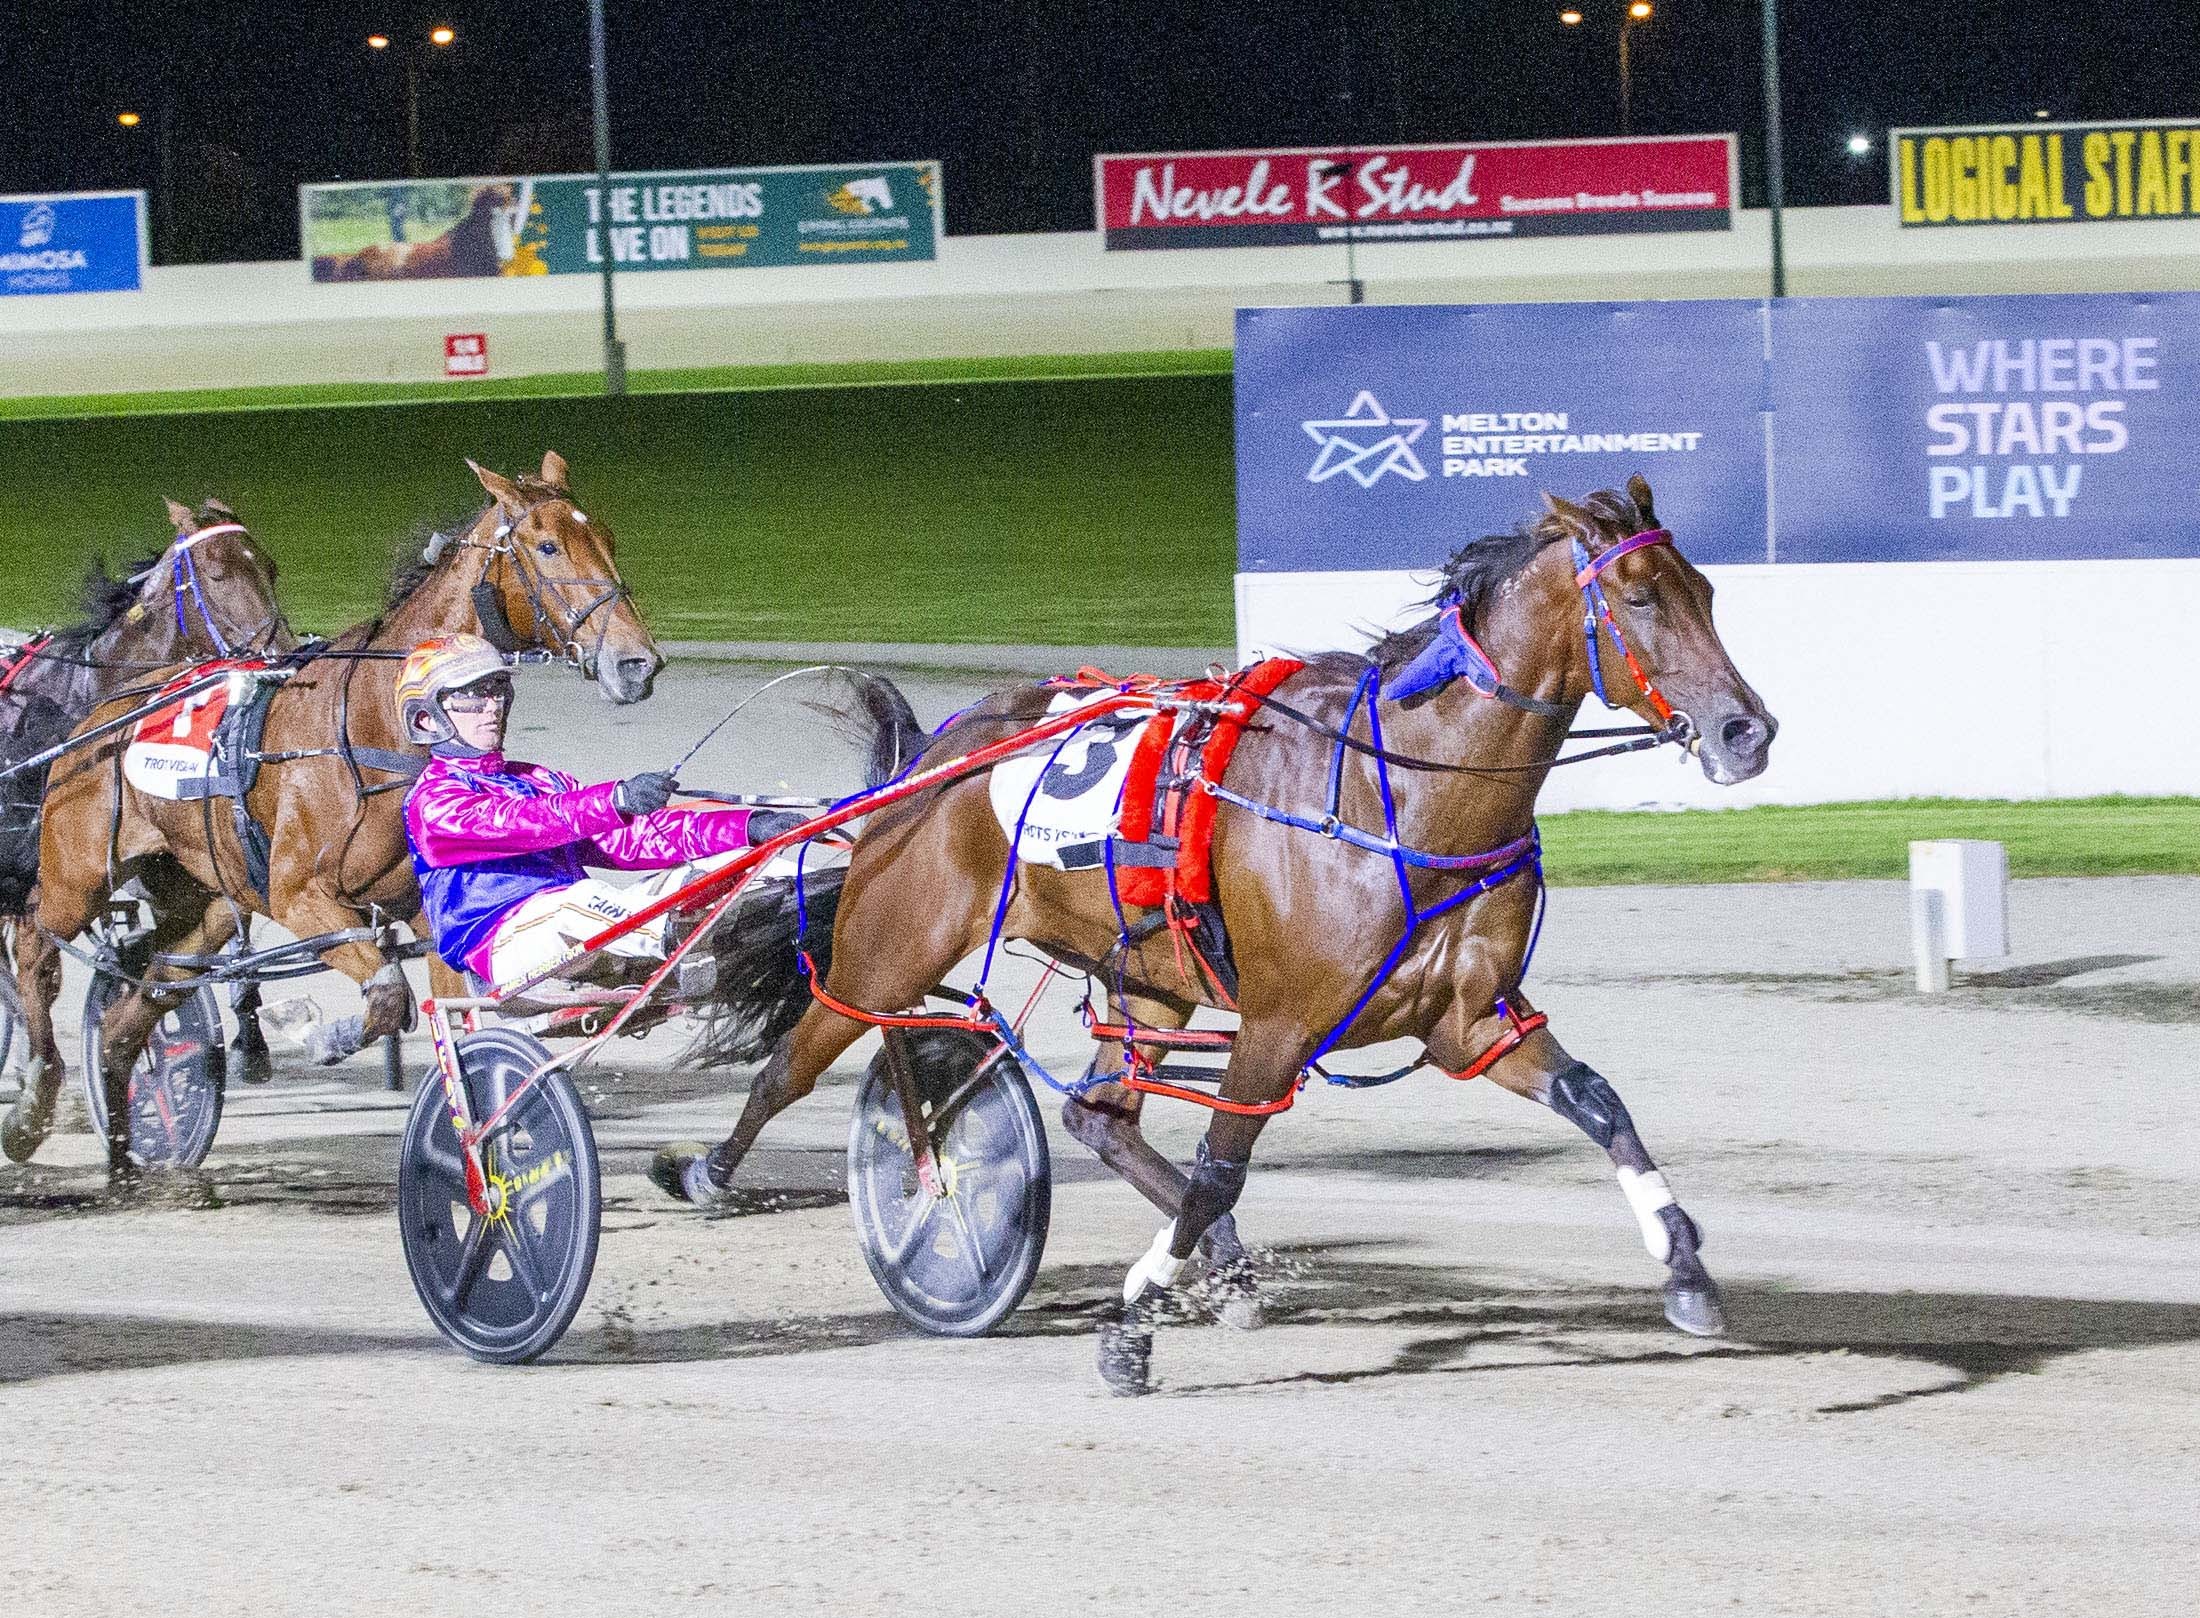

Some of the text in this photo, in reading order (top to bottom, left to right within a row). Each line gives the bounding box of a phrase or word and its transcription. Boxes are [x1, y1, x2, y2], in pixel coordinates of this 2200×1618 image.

[1129, 159, 1294, 226] Nevele
[1355, 154, 1480, 218] Stud
[1901, 134, 2074, 222] LOGICAL
[642, 183, 764, 222] LEGENDS
[585, 227, 647, 263] LVE
[650, 225, 689, 261] ON
[1925, 337, 2159, 393] WHERE
[1442, 412, 1568, 432] MELTON
[1442, 432, 1702, 455] ENTERTAINMENT
[1926, 401, 2129, 456] STARS
[1443, 457, 1528, 477] PARK
[1929, 464, 2082, 518] PLAY
